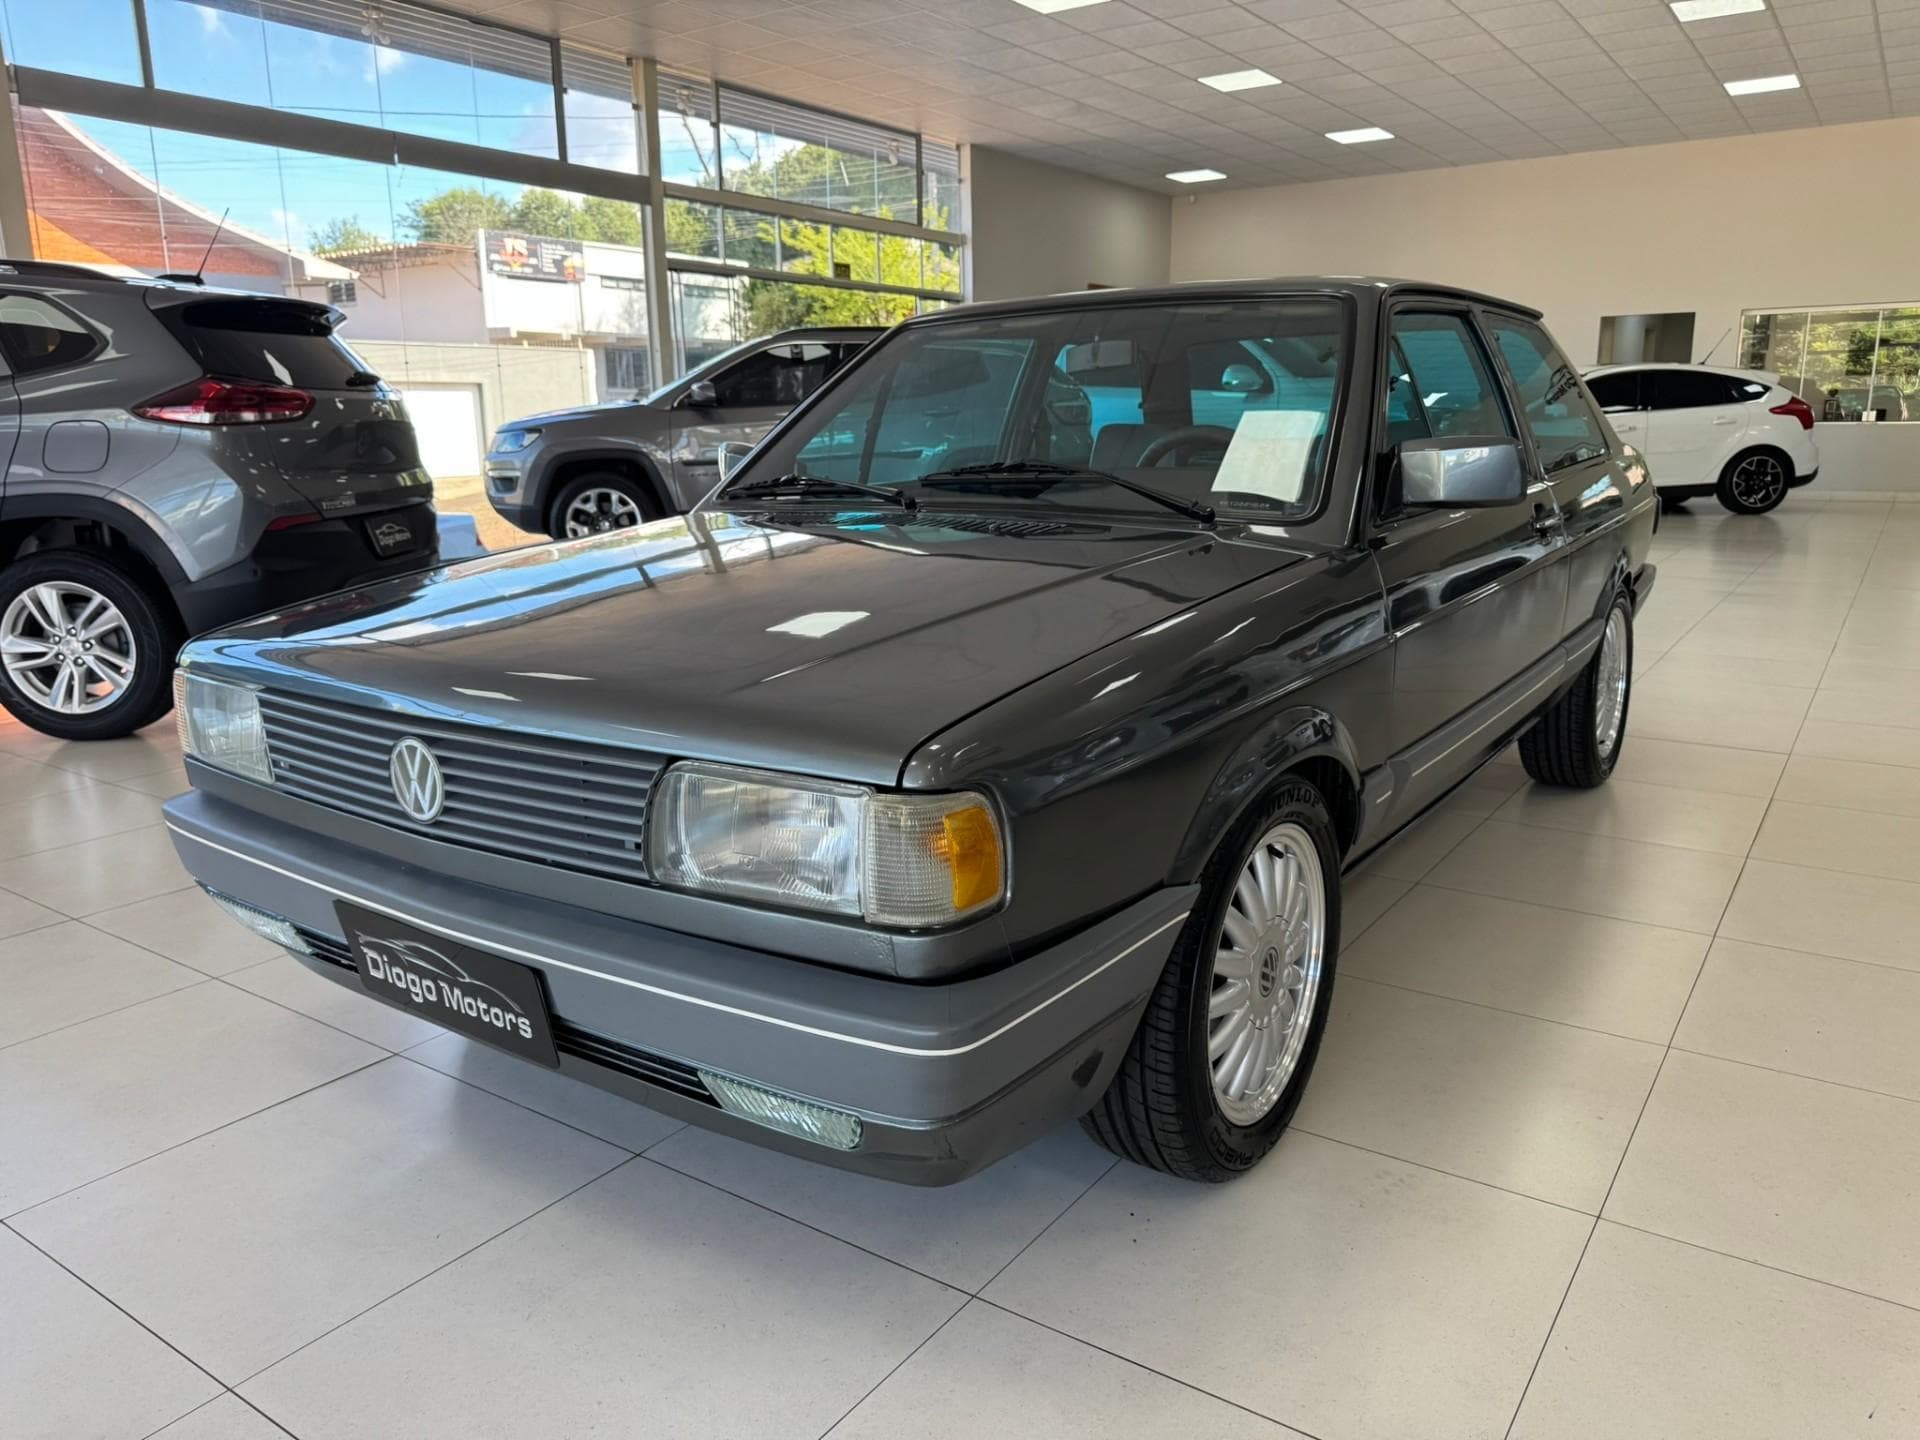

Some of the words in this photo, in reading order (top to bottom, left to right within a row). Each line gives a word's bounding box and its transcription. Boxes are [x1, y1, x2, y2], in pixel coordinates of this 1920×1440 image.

[1266, 787, 1320, 817] DUNLOP
[360, 945, 439, 1004] Diogo
[437, 979, 532, 1039] Motors
